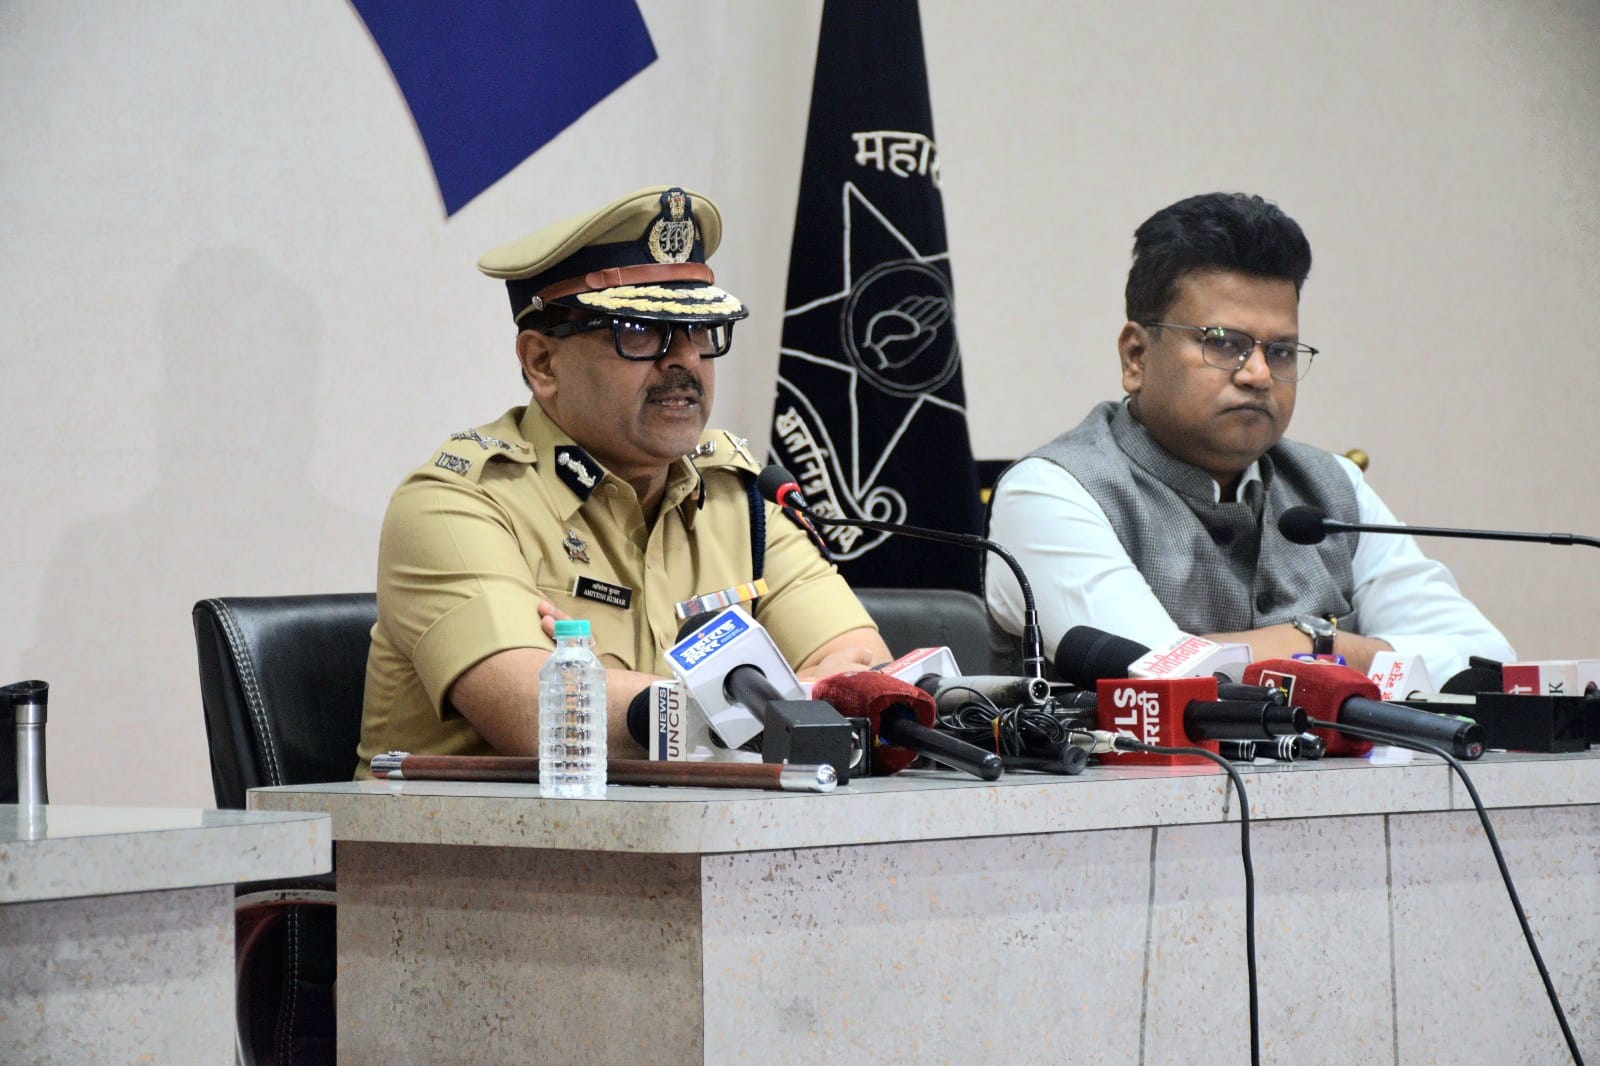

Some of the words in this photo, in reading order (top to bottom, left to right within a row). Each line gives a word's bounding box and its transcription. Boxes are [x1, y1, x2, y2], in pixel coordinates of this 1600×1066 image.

[606, 594, 626, 606] KUMAR
[659, 687, 668, 734] NEWS
[668, 688, 680, 758] UNCUT
